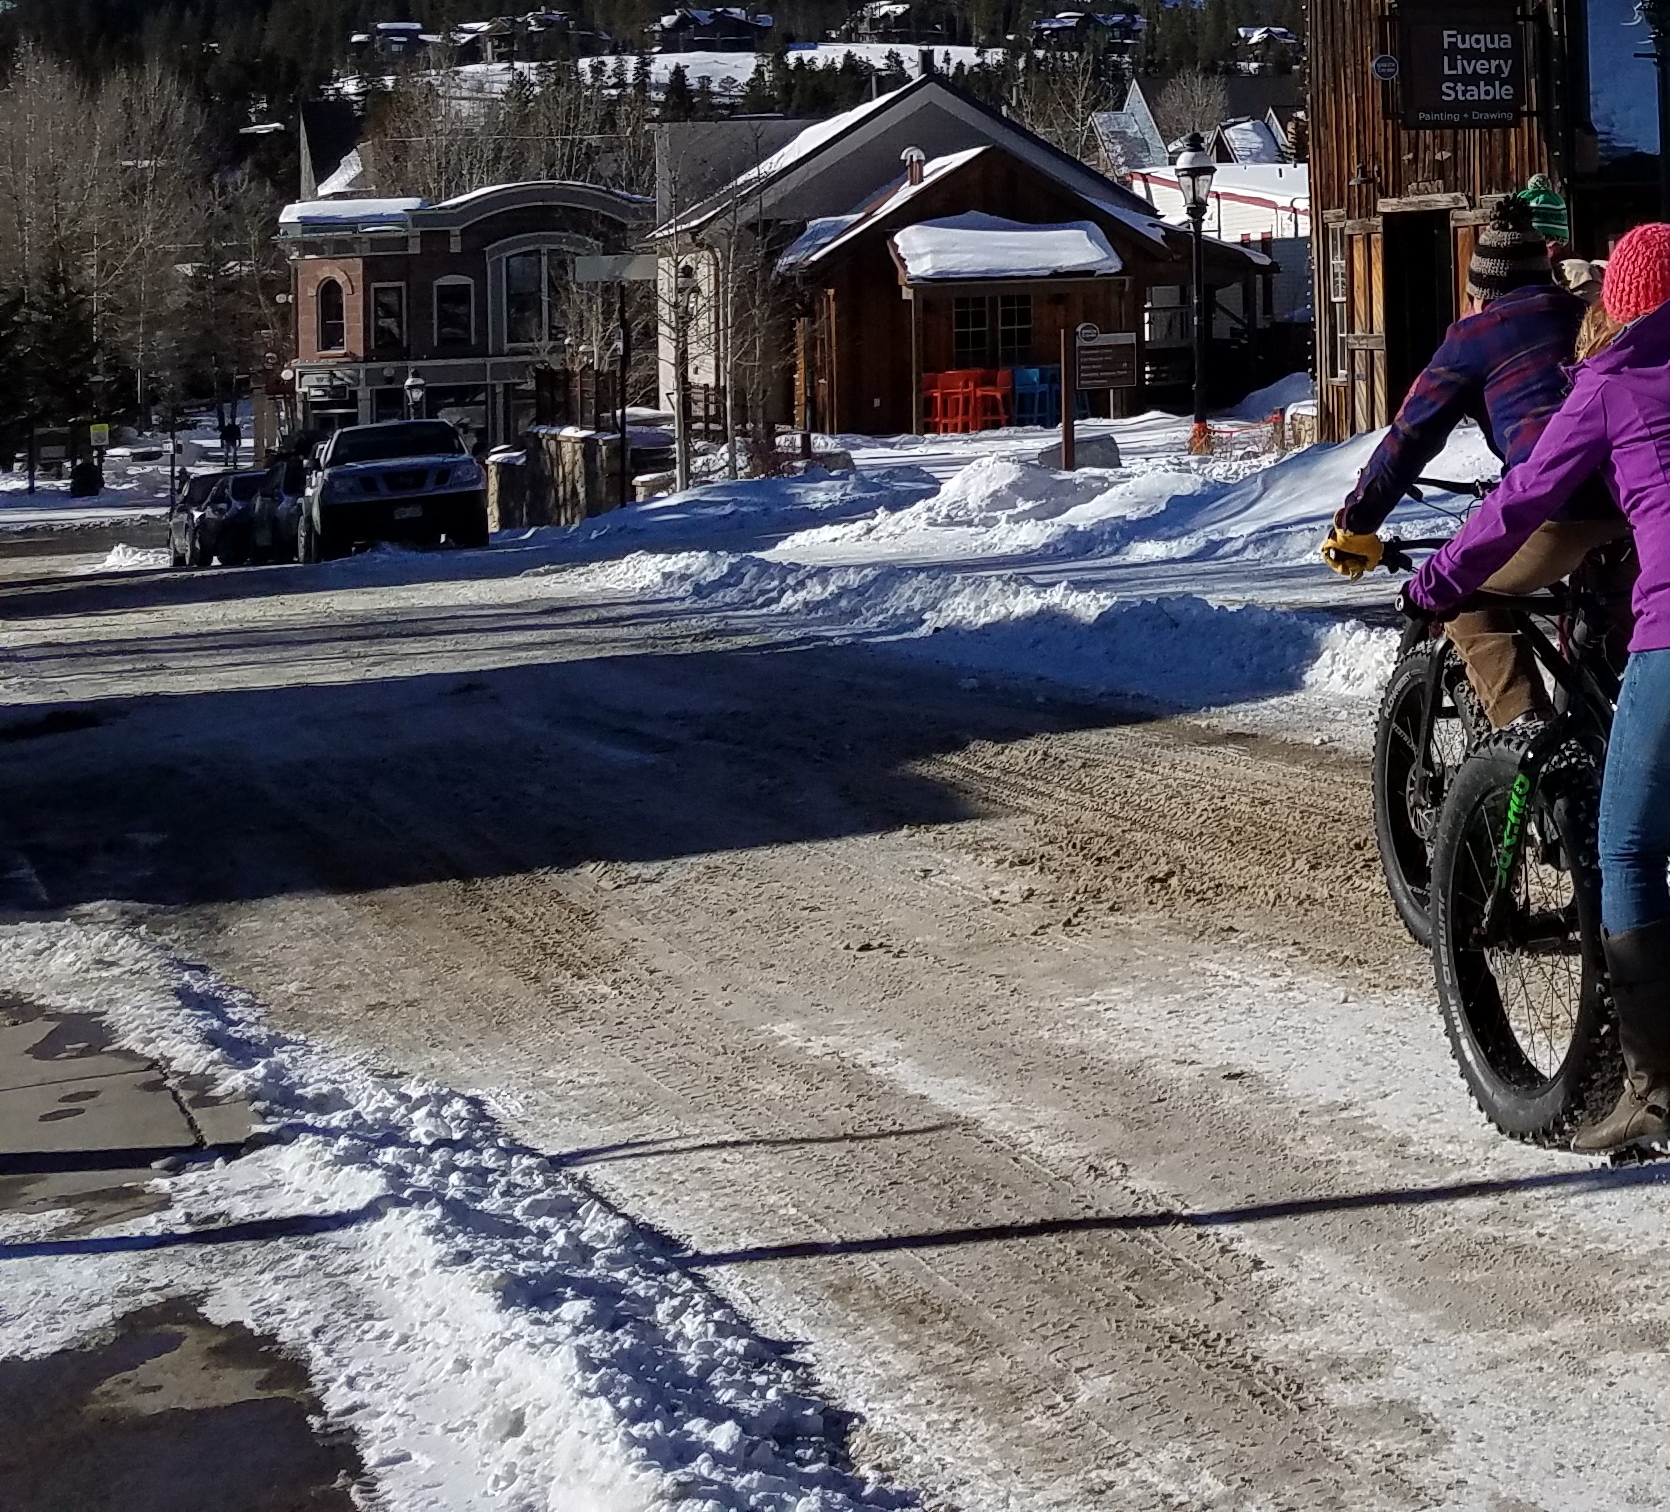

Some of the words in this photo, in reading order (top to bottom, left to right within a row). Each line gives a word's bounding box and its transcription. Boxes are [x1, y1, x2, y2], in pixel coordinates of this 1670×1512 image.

[1442, 30, 1512, 52] Fuqua
[1443, 55, 1512, 77] Livery
[1441, 81, 1514, 101] Stable
[1418, 112, 1460, 122] Painting
[1472, 111, 1513, 121] Drawing
